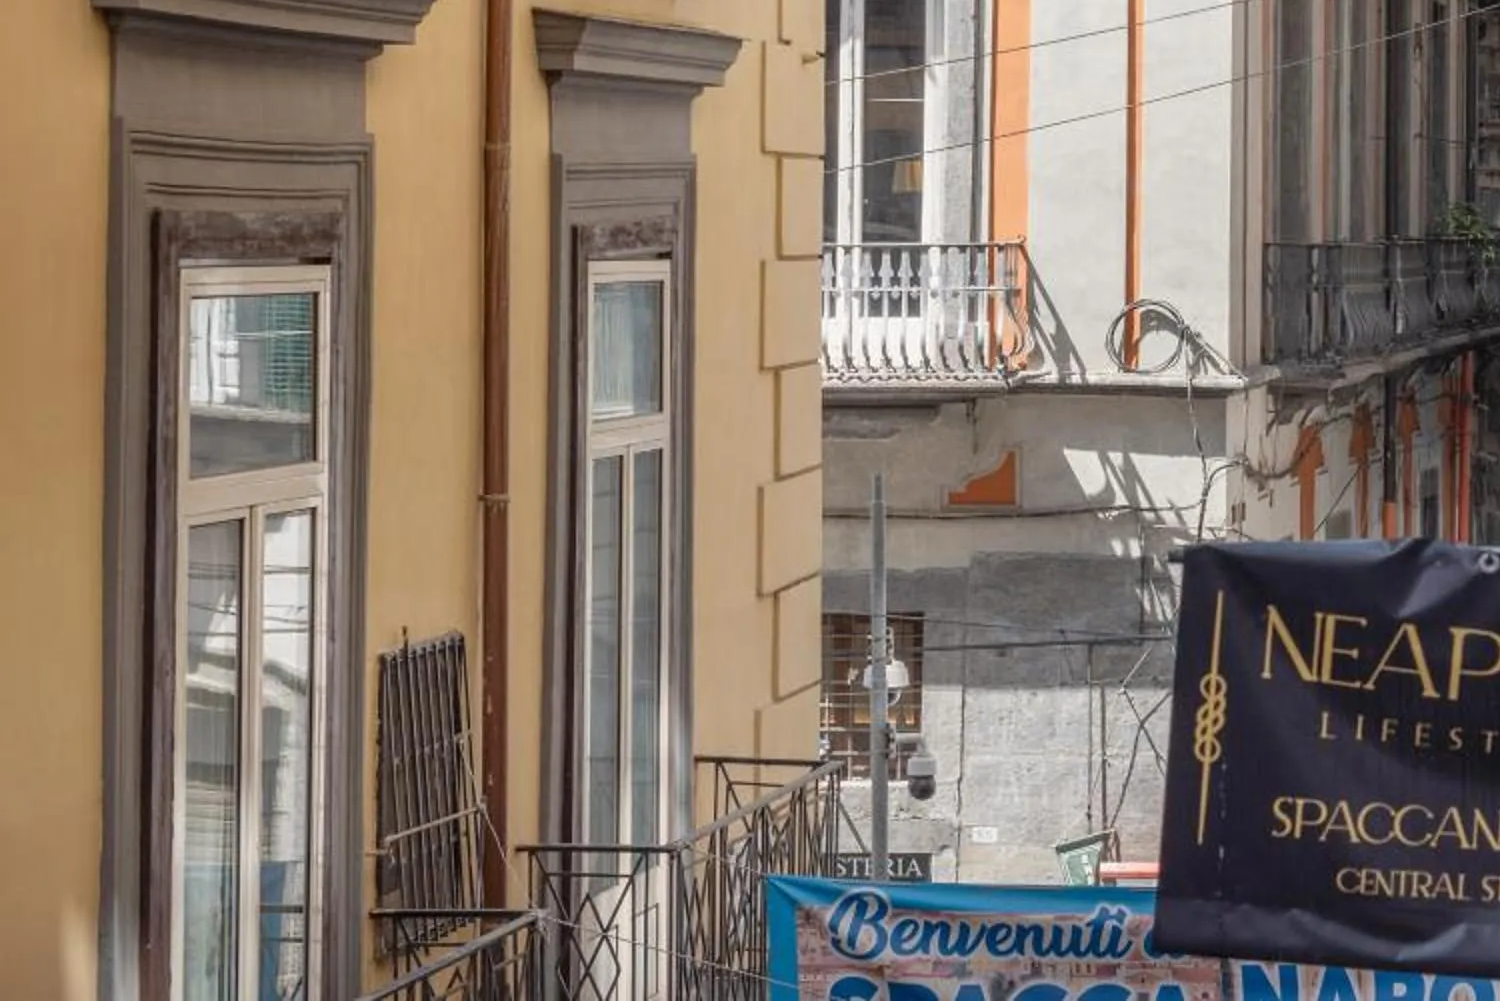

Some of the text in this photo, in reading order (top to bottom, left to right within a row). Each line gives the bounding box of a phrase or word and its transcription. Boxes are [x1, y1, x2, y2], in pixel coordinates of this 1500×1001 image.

[826, 857, 923, 878] STRIA
[1335, 866, 1470, 901] CENTRAL
[827, 887, 1135, 960] Benvenuti
